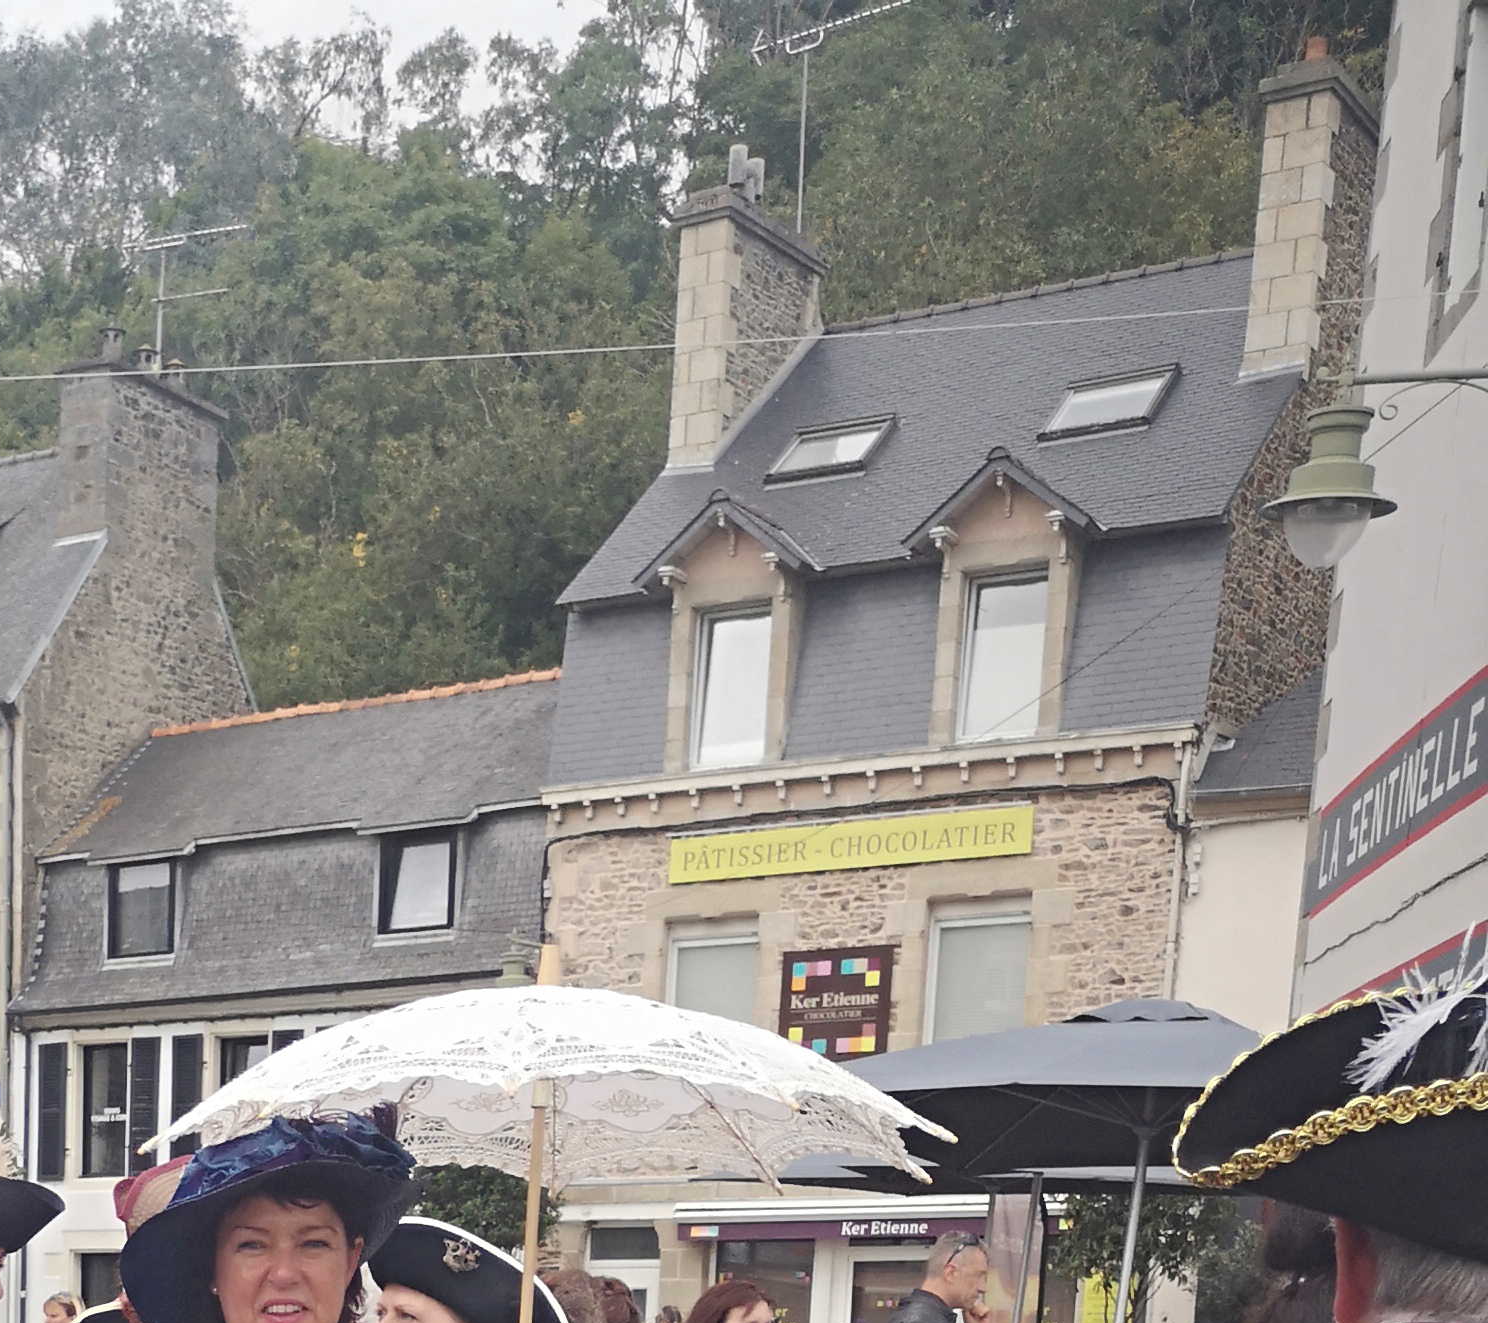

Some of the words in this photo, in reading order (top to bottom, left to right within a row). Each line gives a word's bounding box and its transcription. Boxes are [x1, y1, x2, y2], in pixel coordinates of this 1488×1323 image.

[683, 842, 807, 872] PÂTISSIER
[829, 822, 1017, 858] CHOCOLATIER
[1318, 817, 1342, 889] LA
[790, 994, 820, 1009] Ker
[822, 992, 879, 1008] Etienne
[841, 1221, 869, 1236] Ker
[870, 1221, 929, 1235] Etienne
